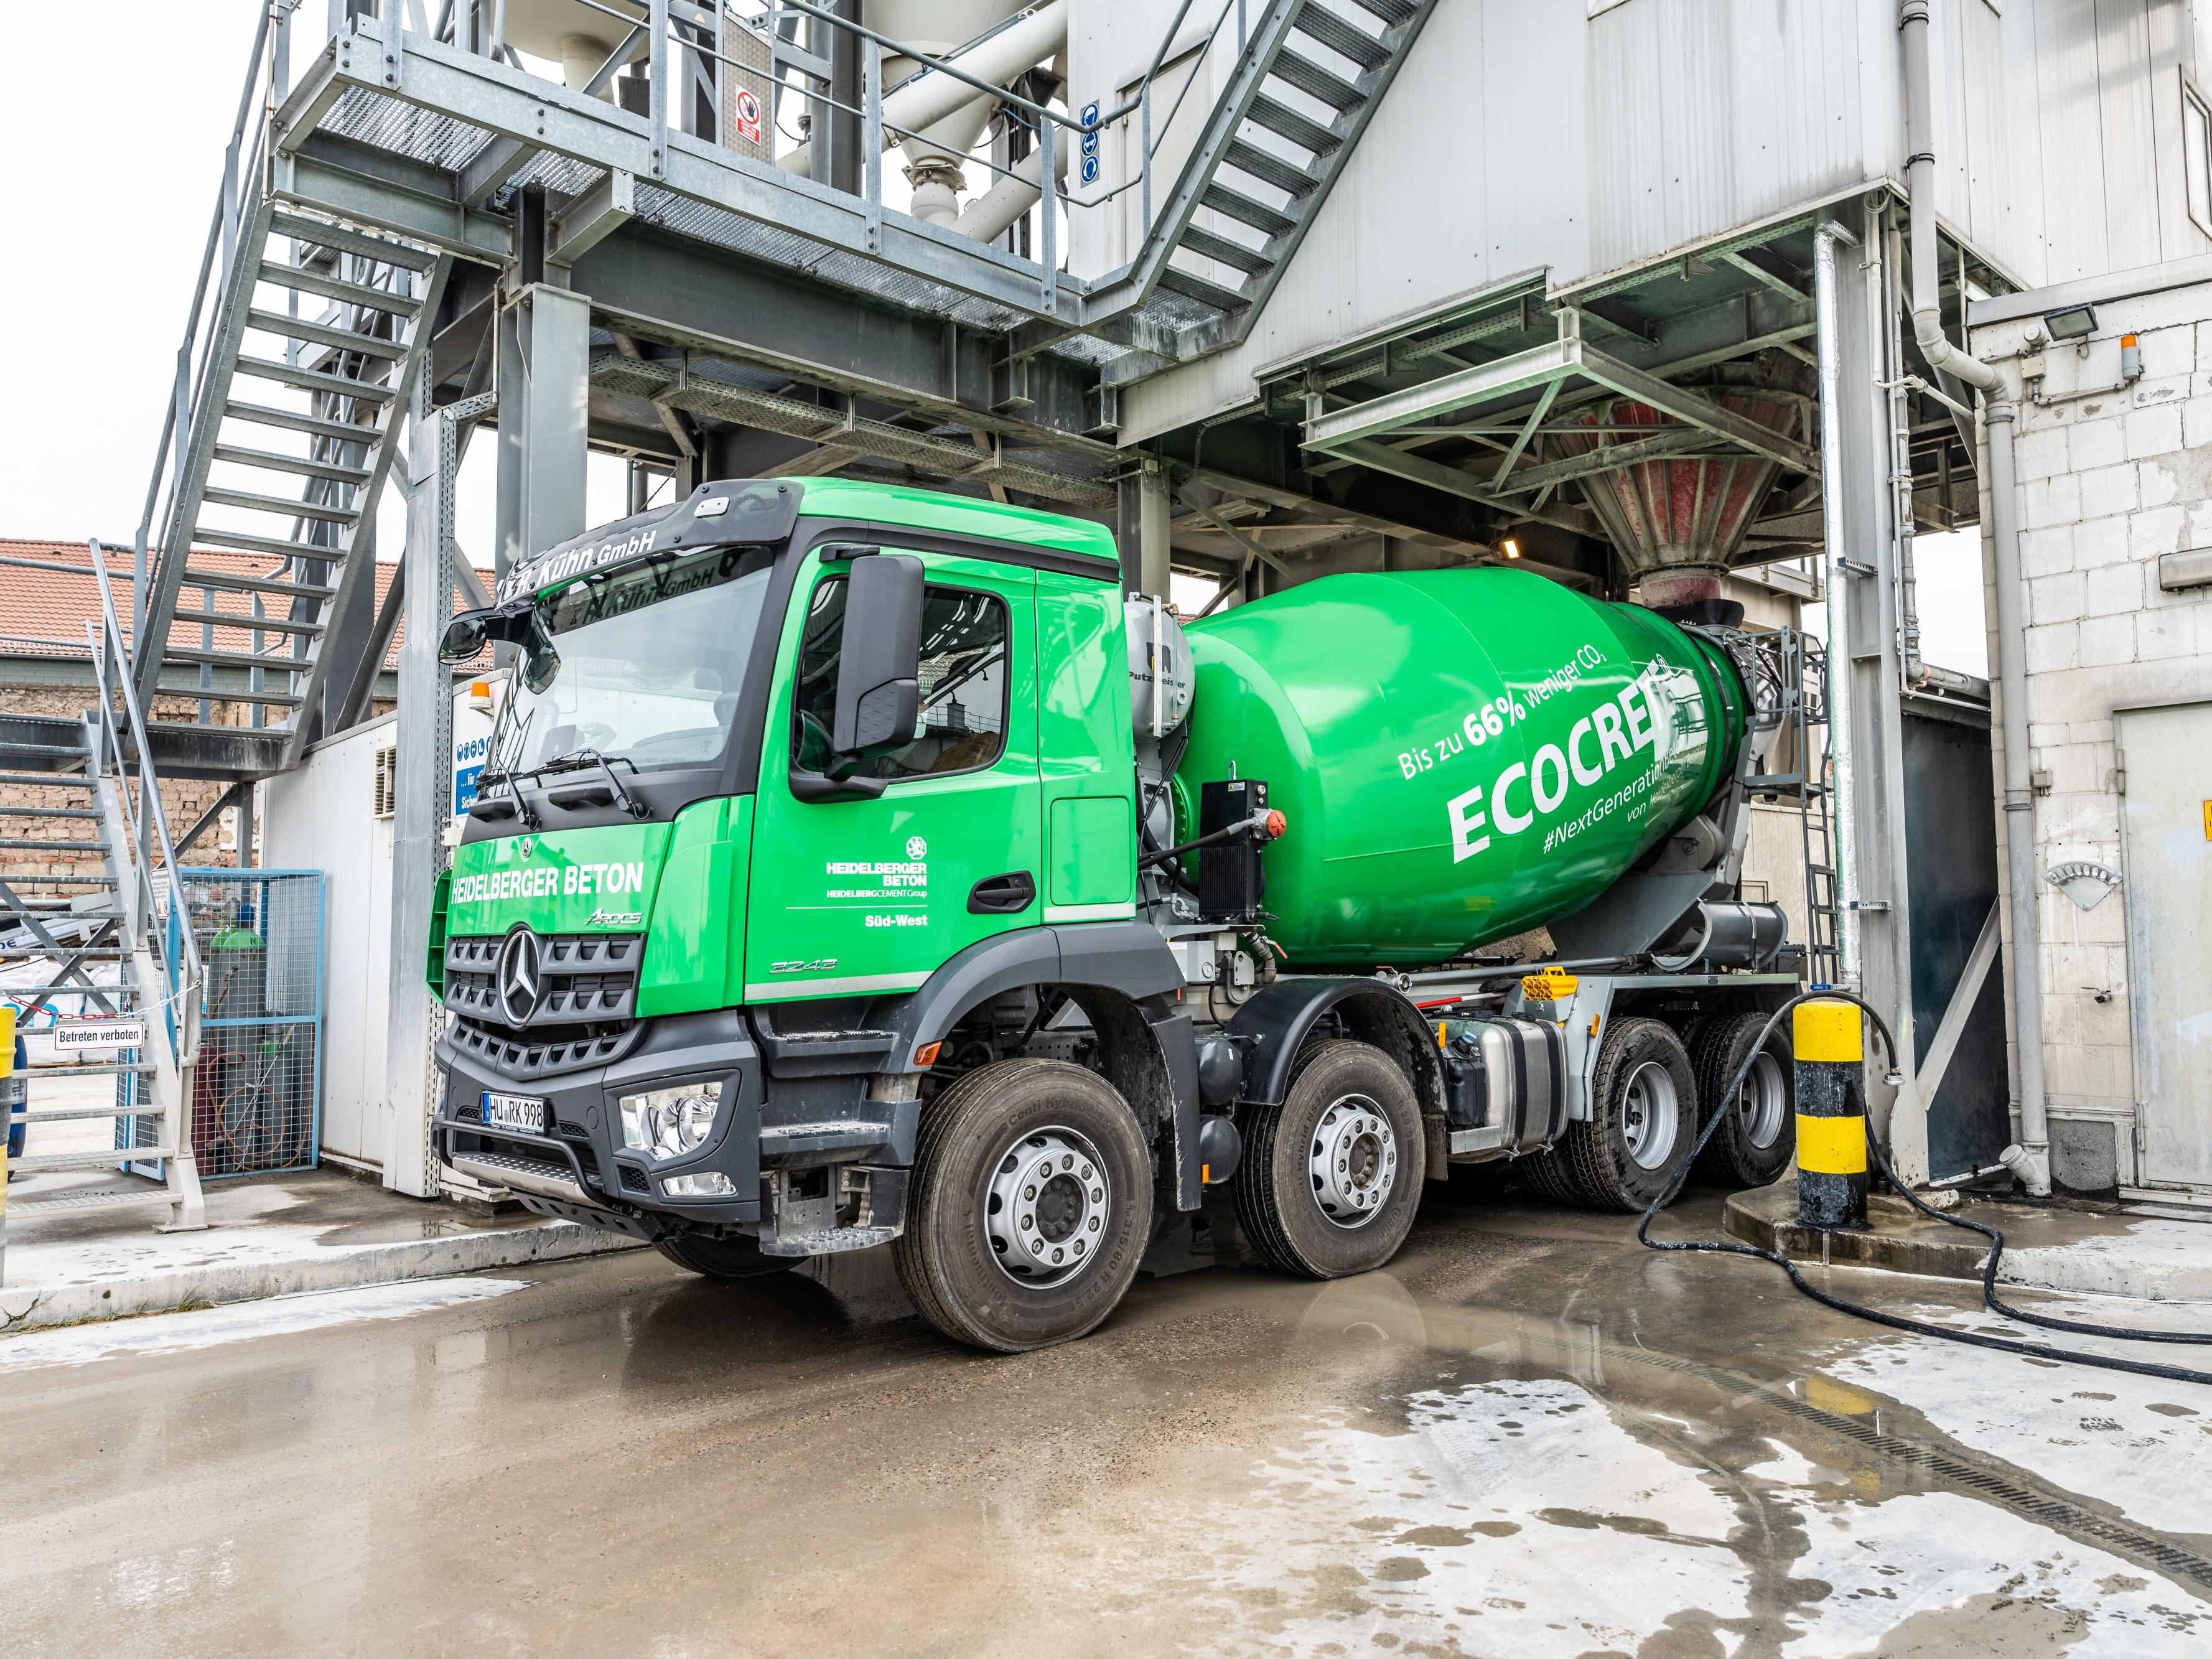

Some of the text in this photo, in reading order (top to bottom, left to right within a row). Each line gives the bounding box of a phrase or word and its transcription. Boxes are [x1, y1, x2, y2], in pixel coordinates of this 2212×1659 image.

[536, 548, 594, 588] Kühn
[597, 530, 658, 564] GmbH
[1129, 671, 1186, 689] Putzeiser
[1398, 747, 1433, 780] Bis
[1434, 732, 1464, 762] zu
[1463, 689, 1526, 746] 66%
[1523, 659, 1582, 709] weniger
[461, 795, 478, 810] Sicher
[1627, 802, 1646, 823] von
[1650, 762, 1686, 806] Heidelberger
[826, 862, 927, 874] HEIDELBERGER
[450, 861, 644, 905] HEIDELBERGER BETON
[882, 874, 927, 887] BETON
[826, 890, 928, 899] HEIDELBERGCEMENT Group
[864, 915, 928, 927] Süd-West
[769, 958, 838, 974] 3243
[59, 1029, 139, 1042] Betreten verboten
[490, 1097, 543, 1128] HU RK 998
[1009, 1100, 1041, 1126] Conti
[1297, 1124, 1309, 1172] Hybrid
[1109, 1219, 1133, 1270] 315/80
